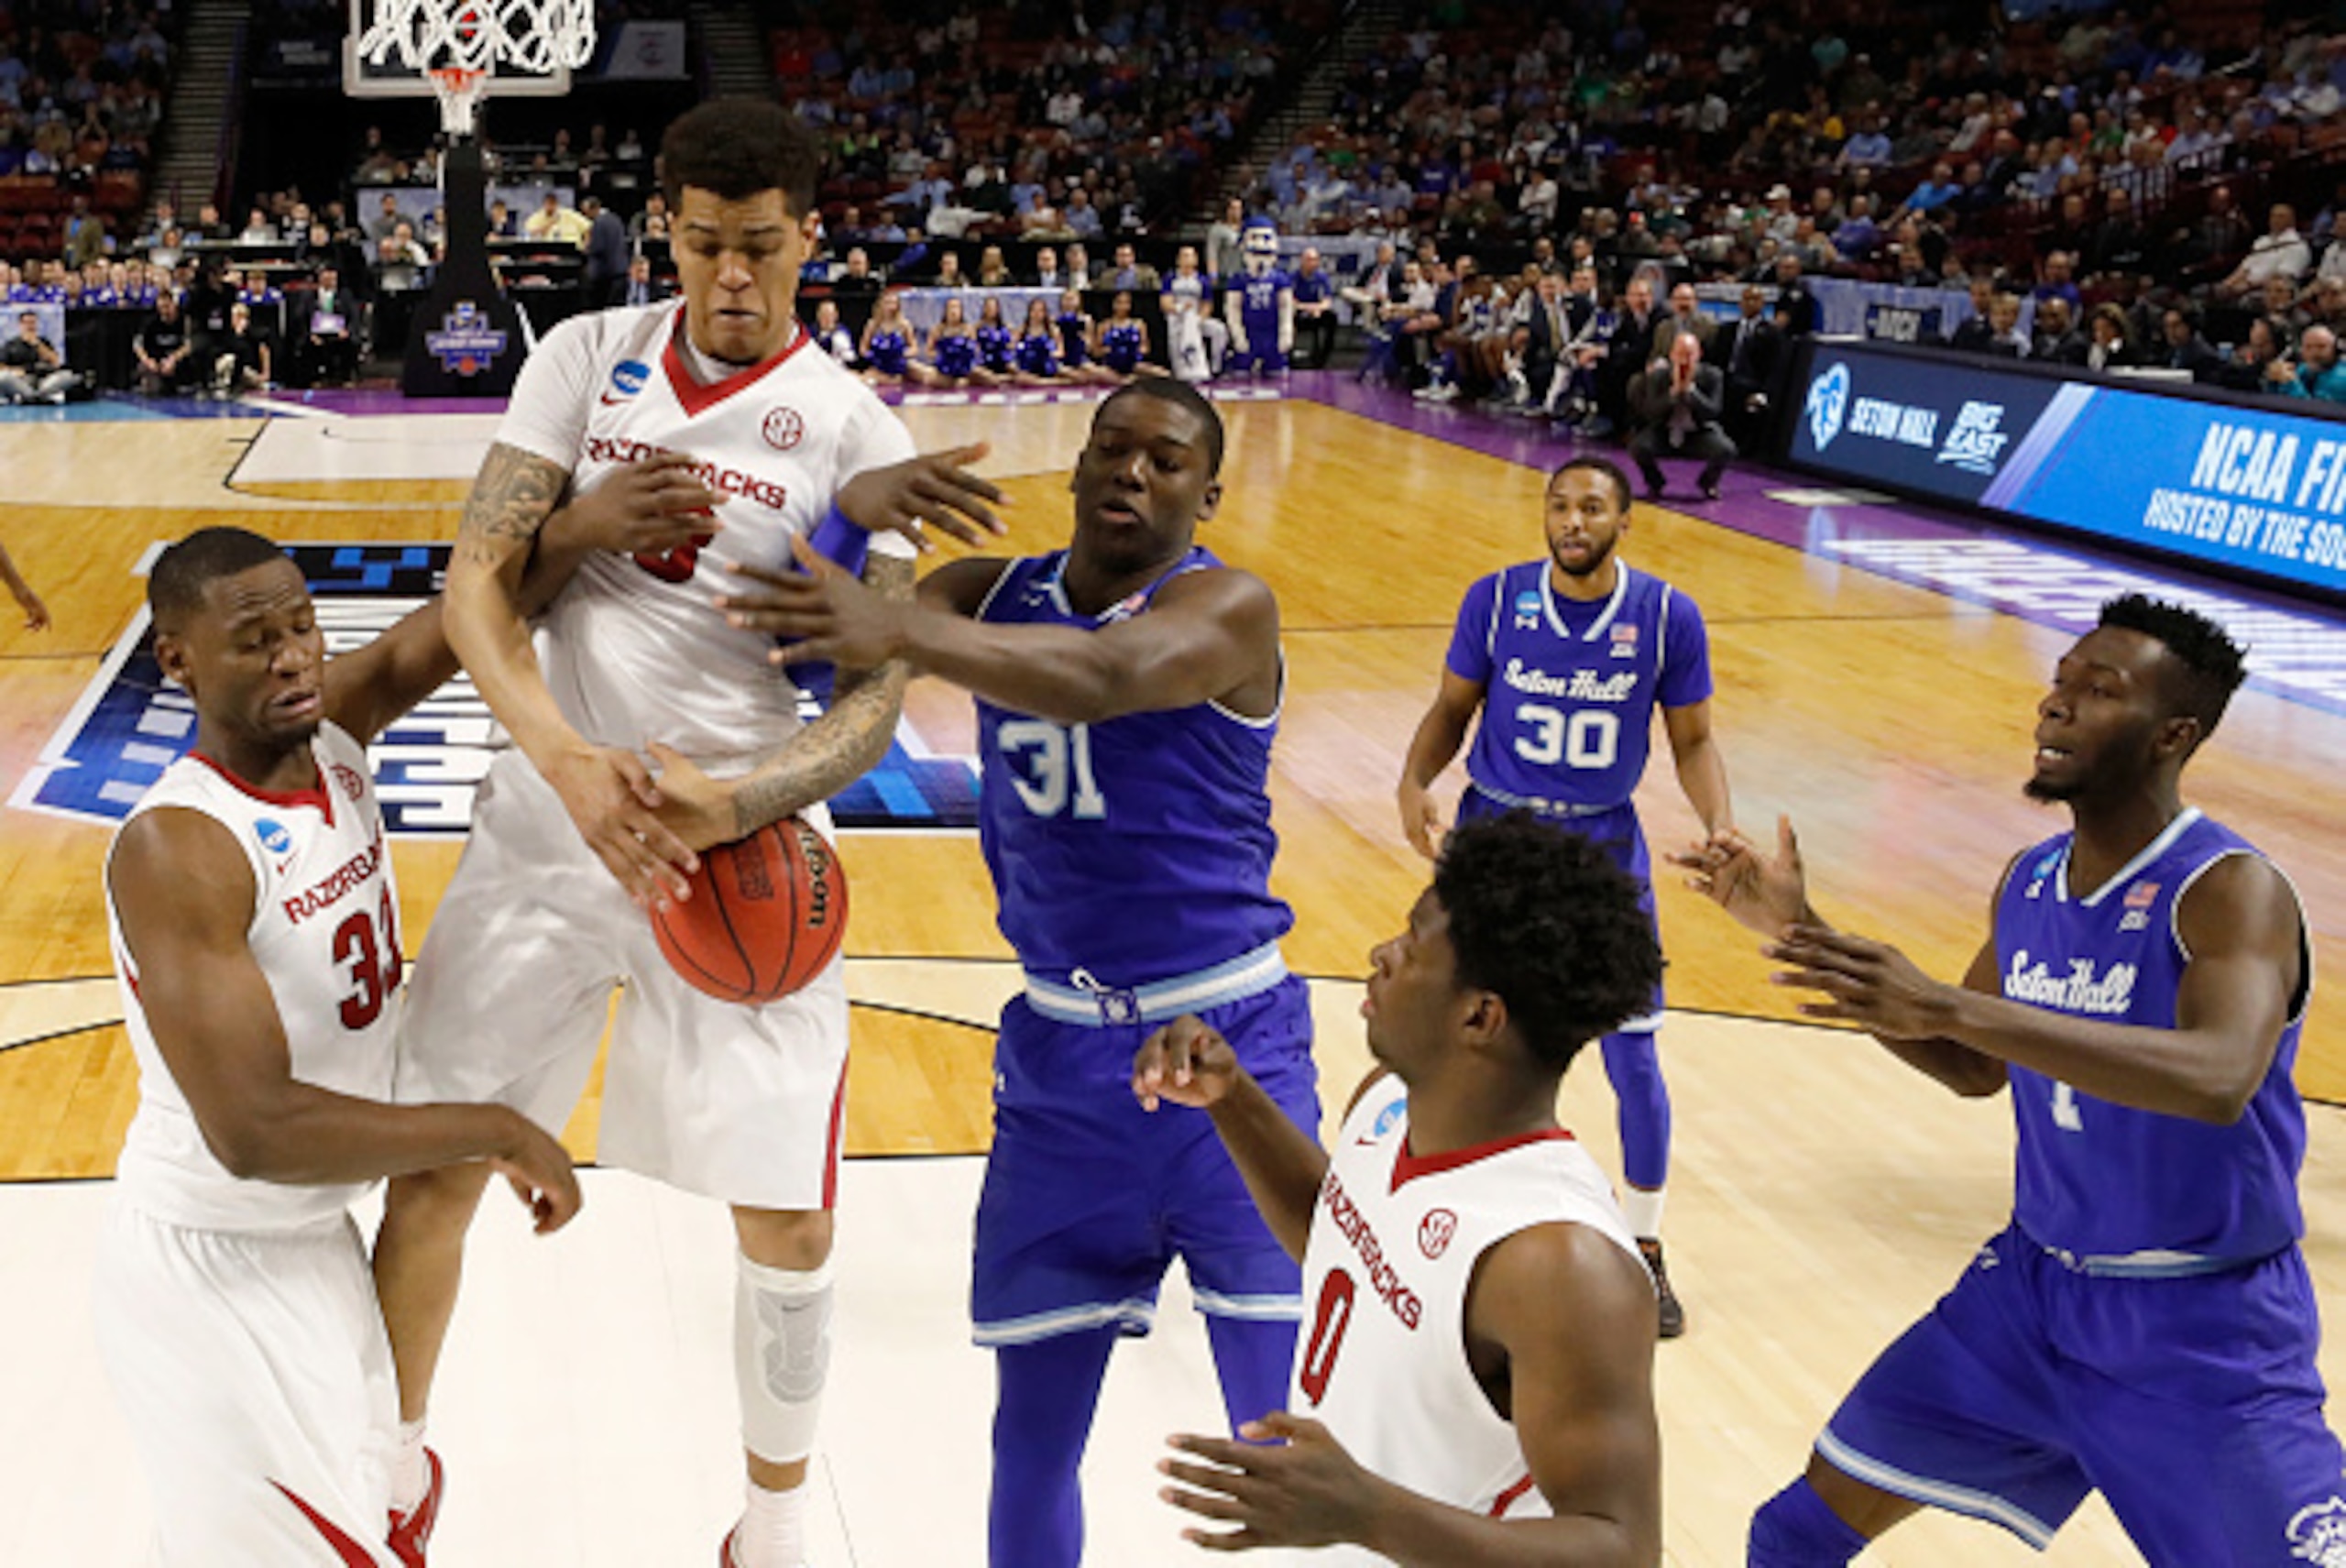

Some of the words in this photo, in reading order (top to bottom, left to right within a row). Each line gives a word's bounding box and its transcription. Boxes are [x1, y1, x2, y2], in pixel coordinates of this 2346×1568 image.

[1848, 396, 1902, 440] SETON
[1896, 404, 1940, 448] HALL
[1944, 430, 2009, 459] EAST
[1957, 400, 2005, 433] BIG
[2189, 422, 2300, 504] NCAA
[2142, 487, 2231, 543] HOSTED
[2225, 502, 2265, 550] BY
[2258, 510, 2311, 560] THE
[1503, 656, 1566, 698] Seton
[1566, 668, 1639, 703] Hall
[997, 719, 1107, 820] 31
[1514, 703, 1621, 770] 30
[2003, 948, 2069, 1008] Seton
[2064, 957, 2140, 1015] Hall
[1299, 1266, 1358, 1408] 0
